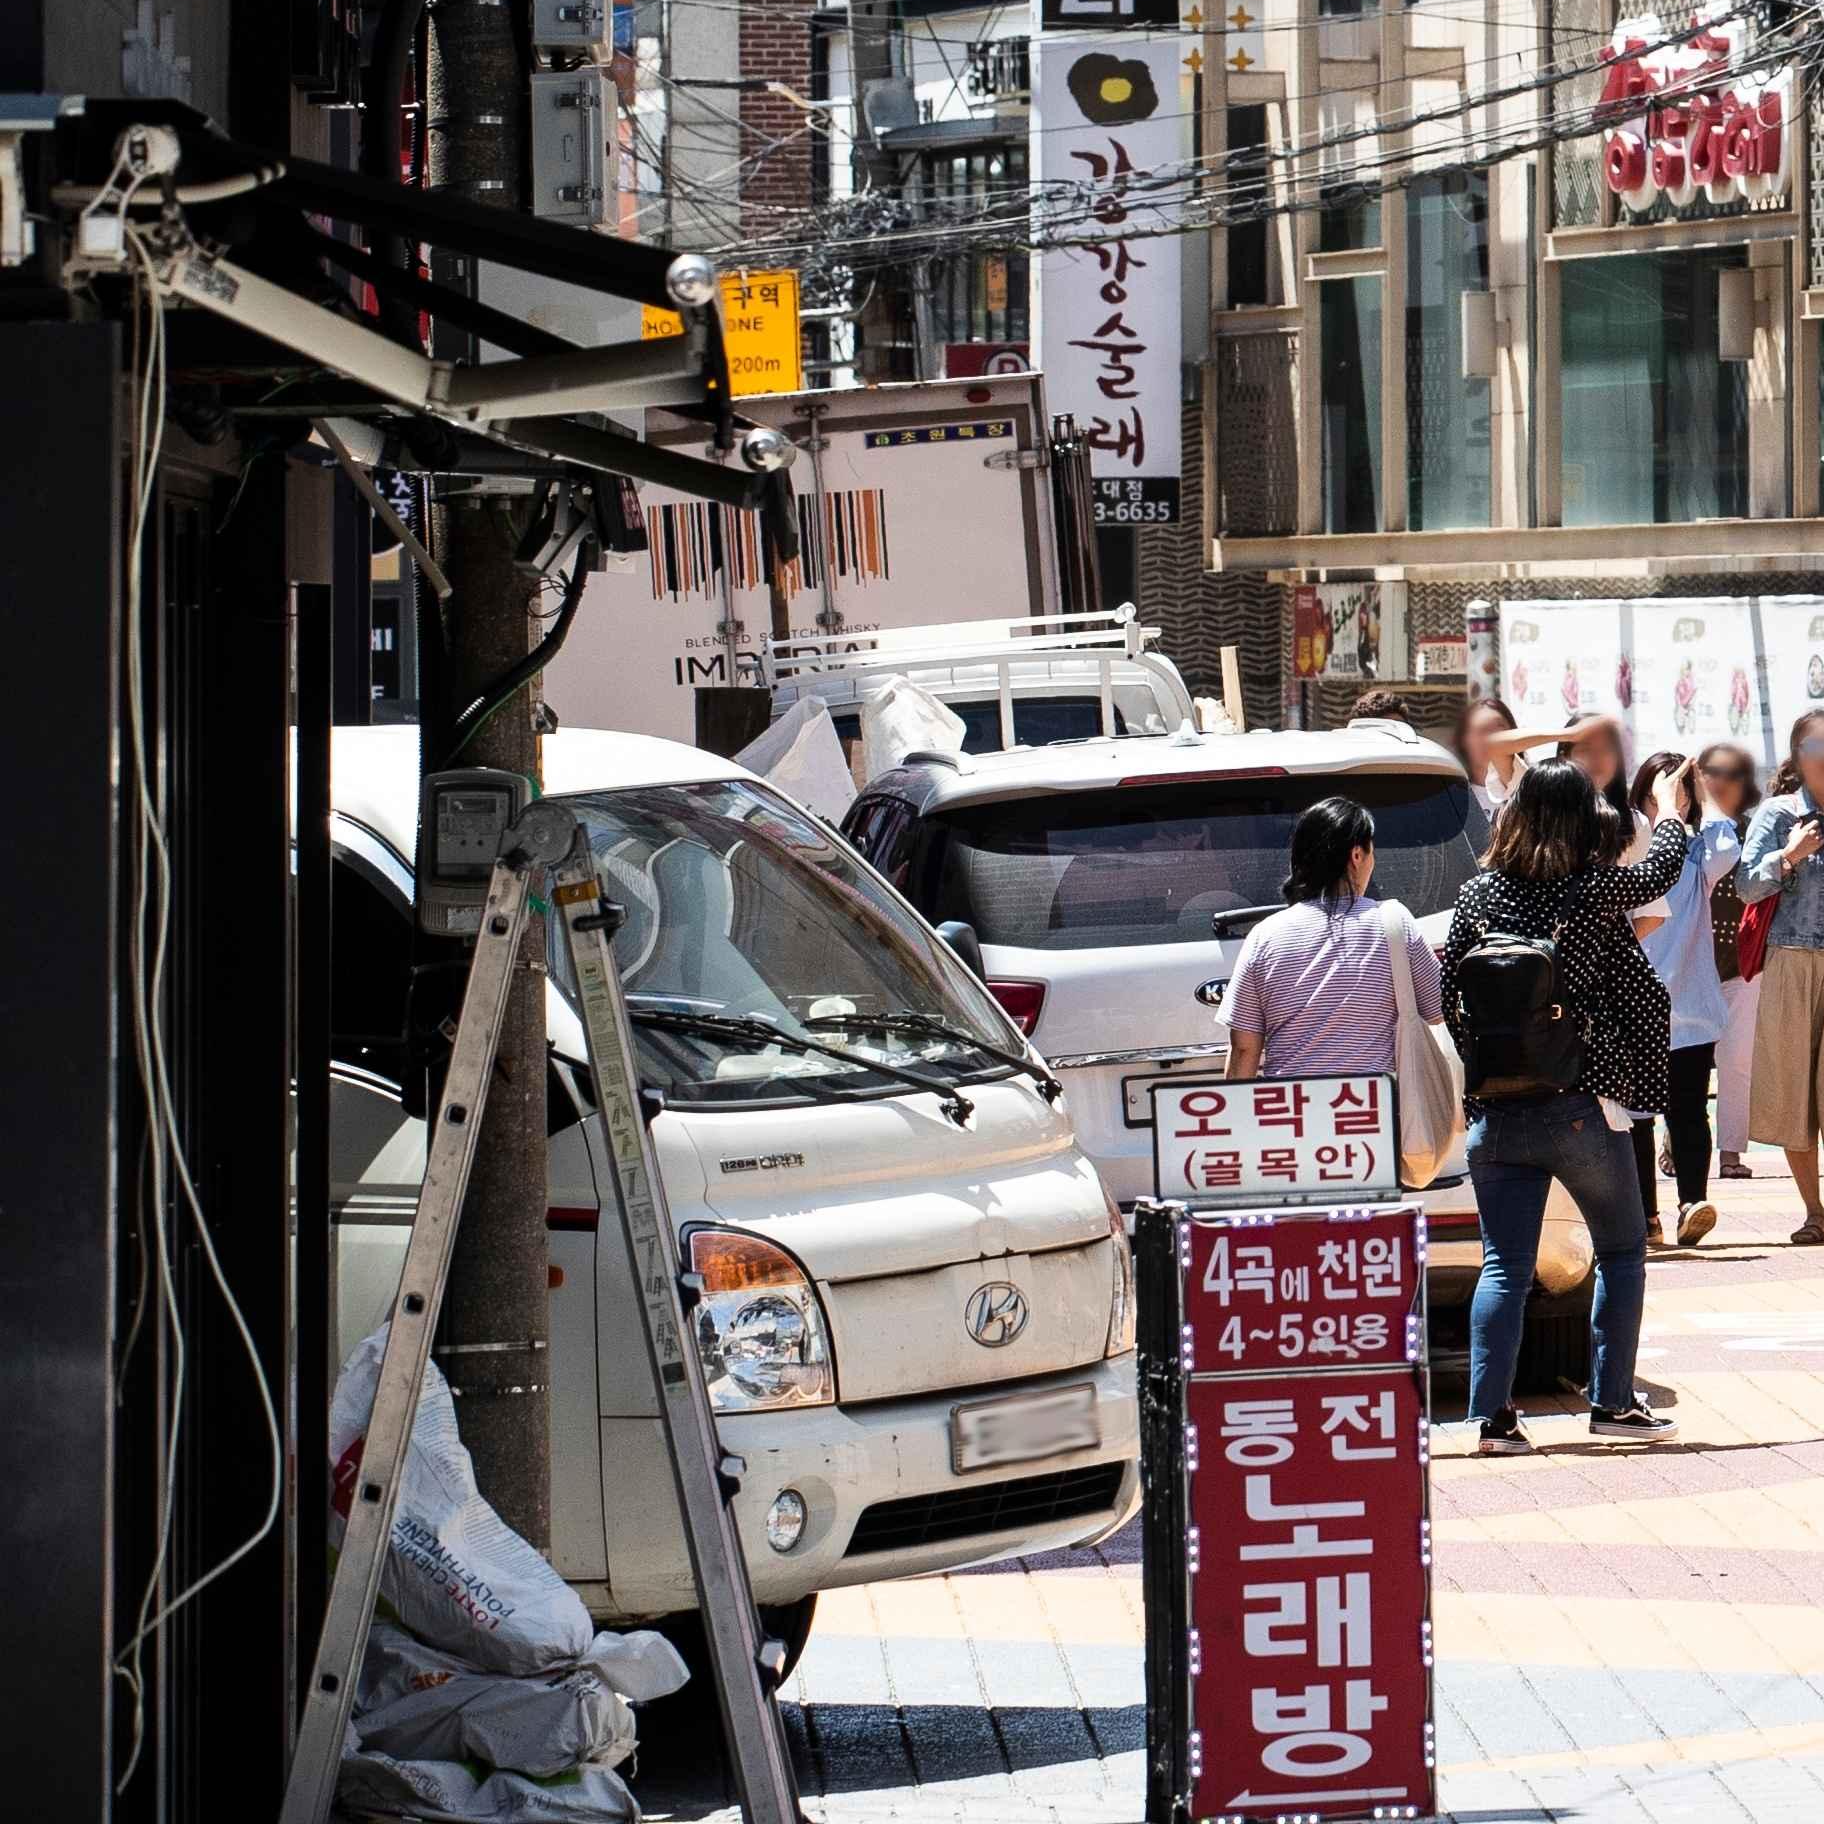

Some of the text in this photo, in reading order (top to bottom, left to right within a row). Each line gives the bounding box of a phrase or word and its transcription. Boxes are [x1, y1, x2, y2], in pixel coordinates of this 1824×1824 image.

[731, 356, 782, 374] 200m
[1173, 1083, 1384, 1138] 오락실
[1183, 1140, 1377, 1189] (골목안)
[1317, 1236, 1404, 1300] 천원
[1219, 1389, 1399, 1468] 동전
[1238, 1473, 1391, 1780] 노래방
